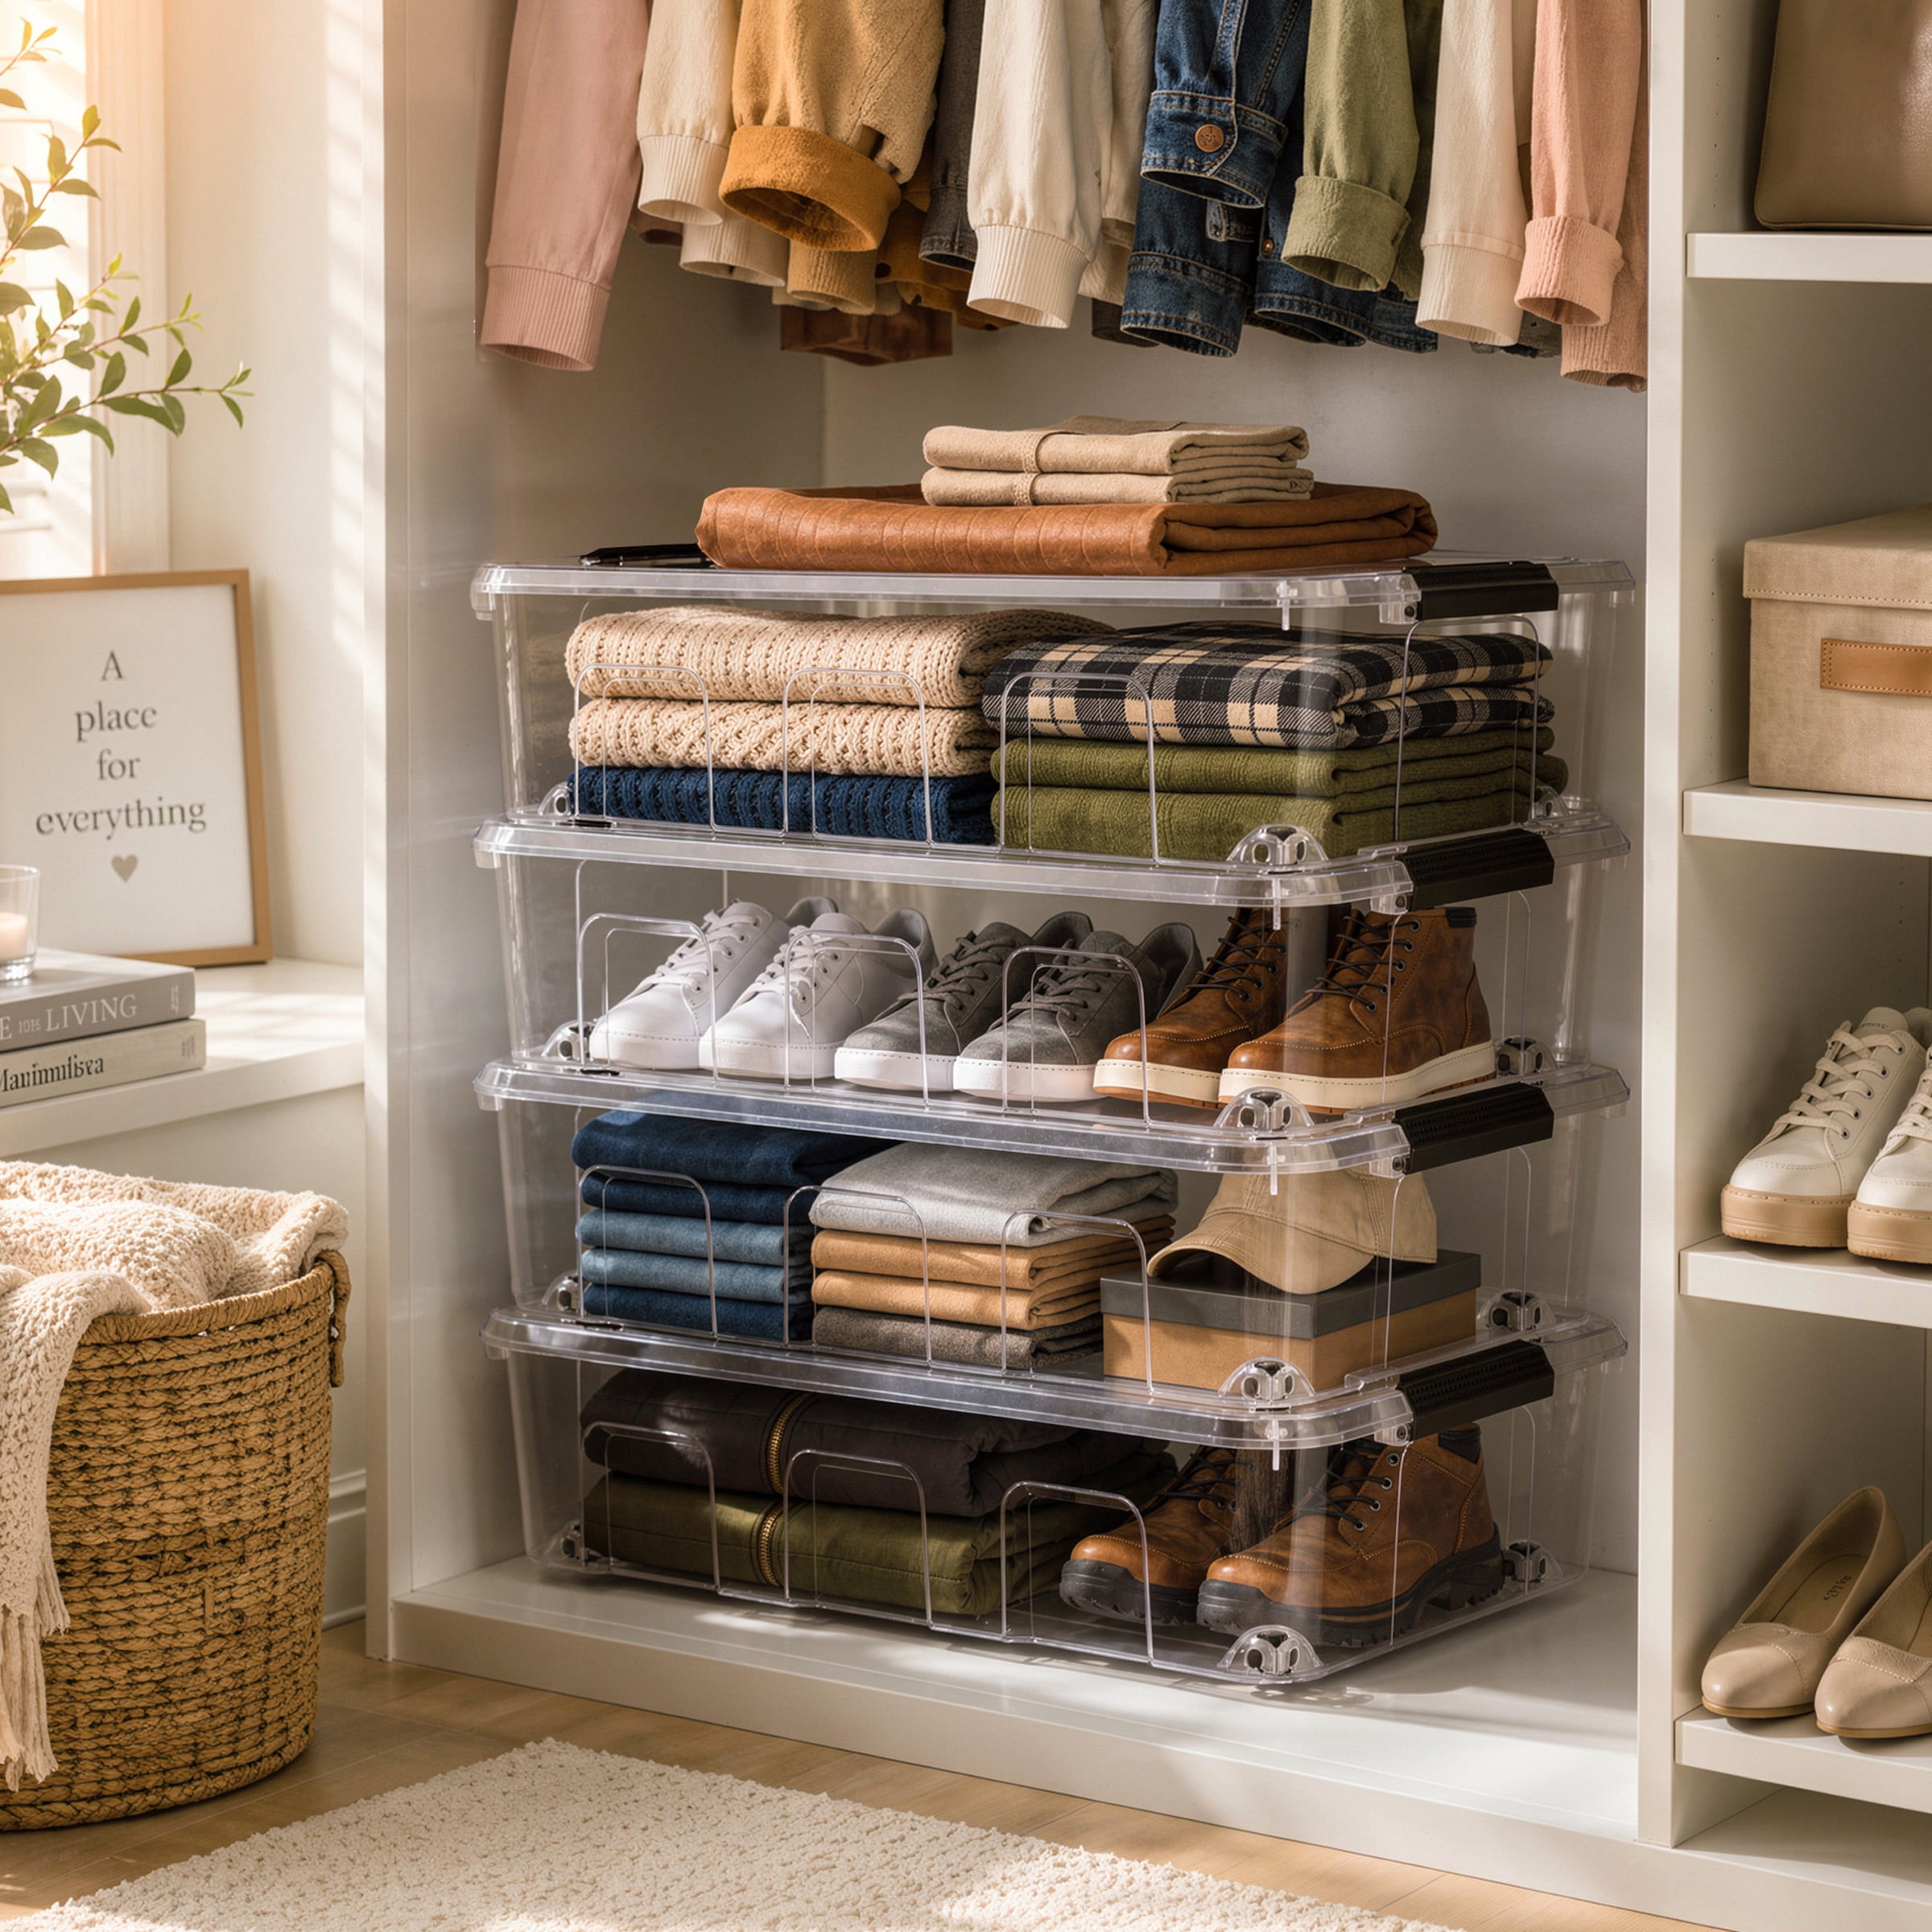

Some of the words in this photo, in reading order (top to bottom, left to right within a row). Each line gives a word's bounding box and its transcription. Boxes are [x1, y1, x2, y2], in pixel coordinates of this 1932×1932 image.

[101, 650, 124, 681] A
[75, 700, 157, 742] place
[97, 749, 141, 780] for
[35, 796, 207, 840] everything
[45, 993, 138, 1032] LIVING
